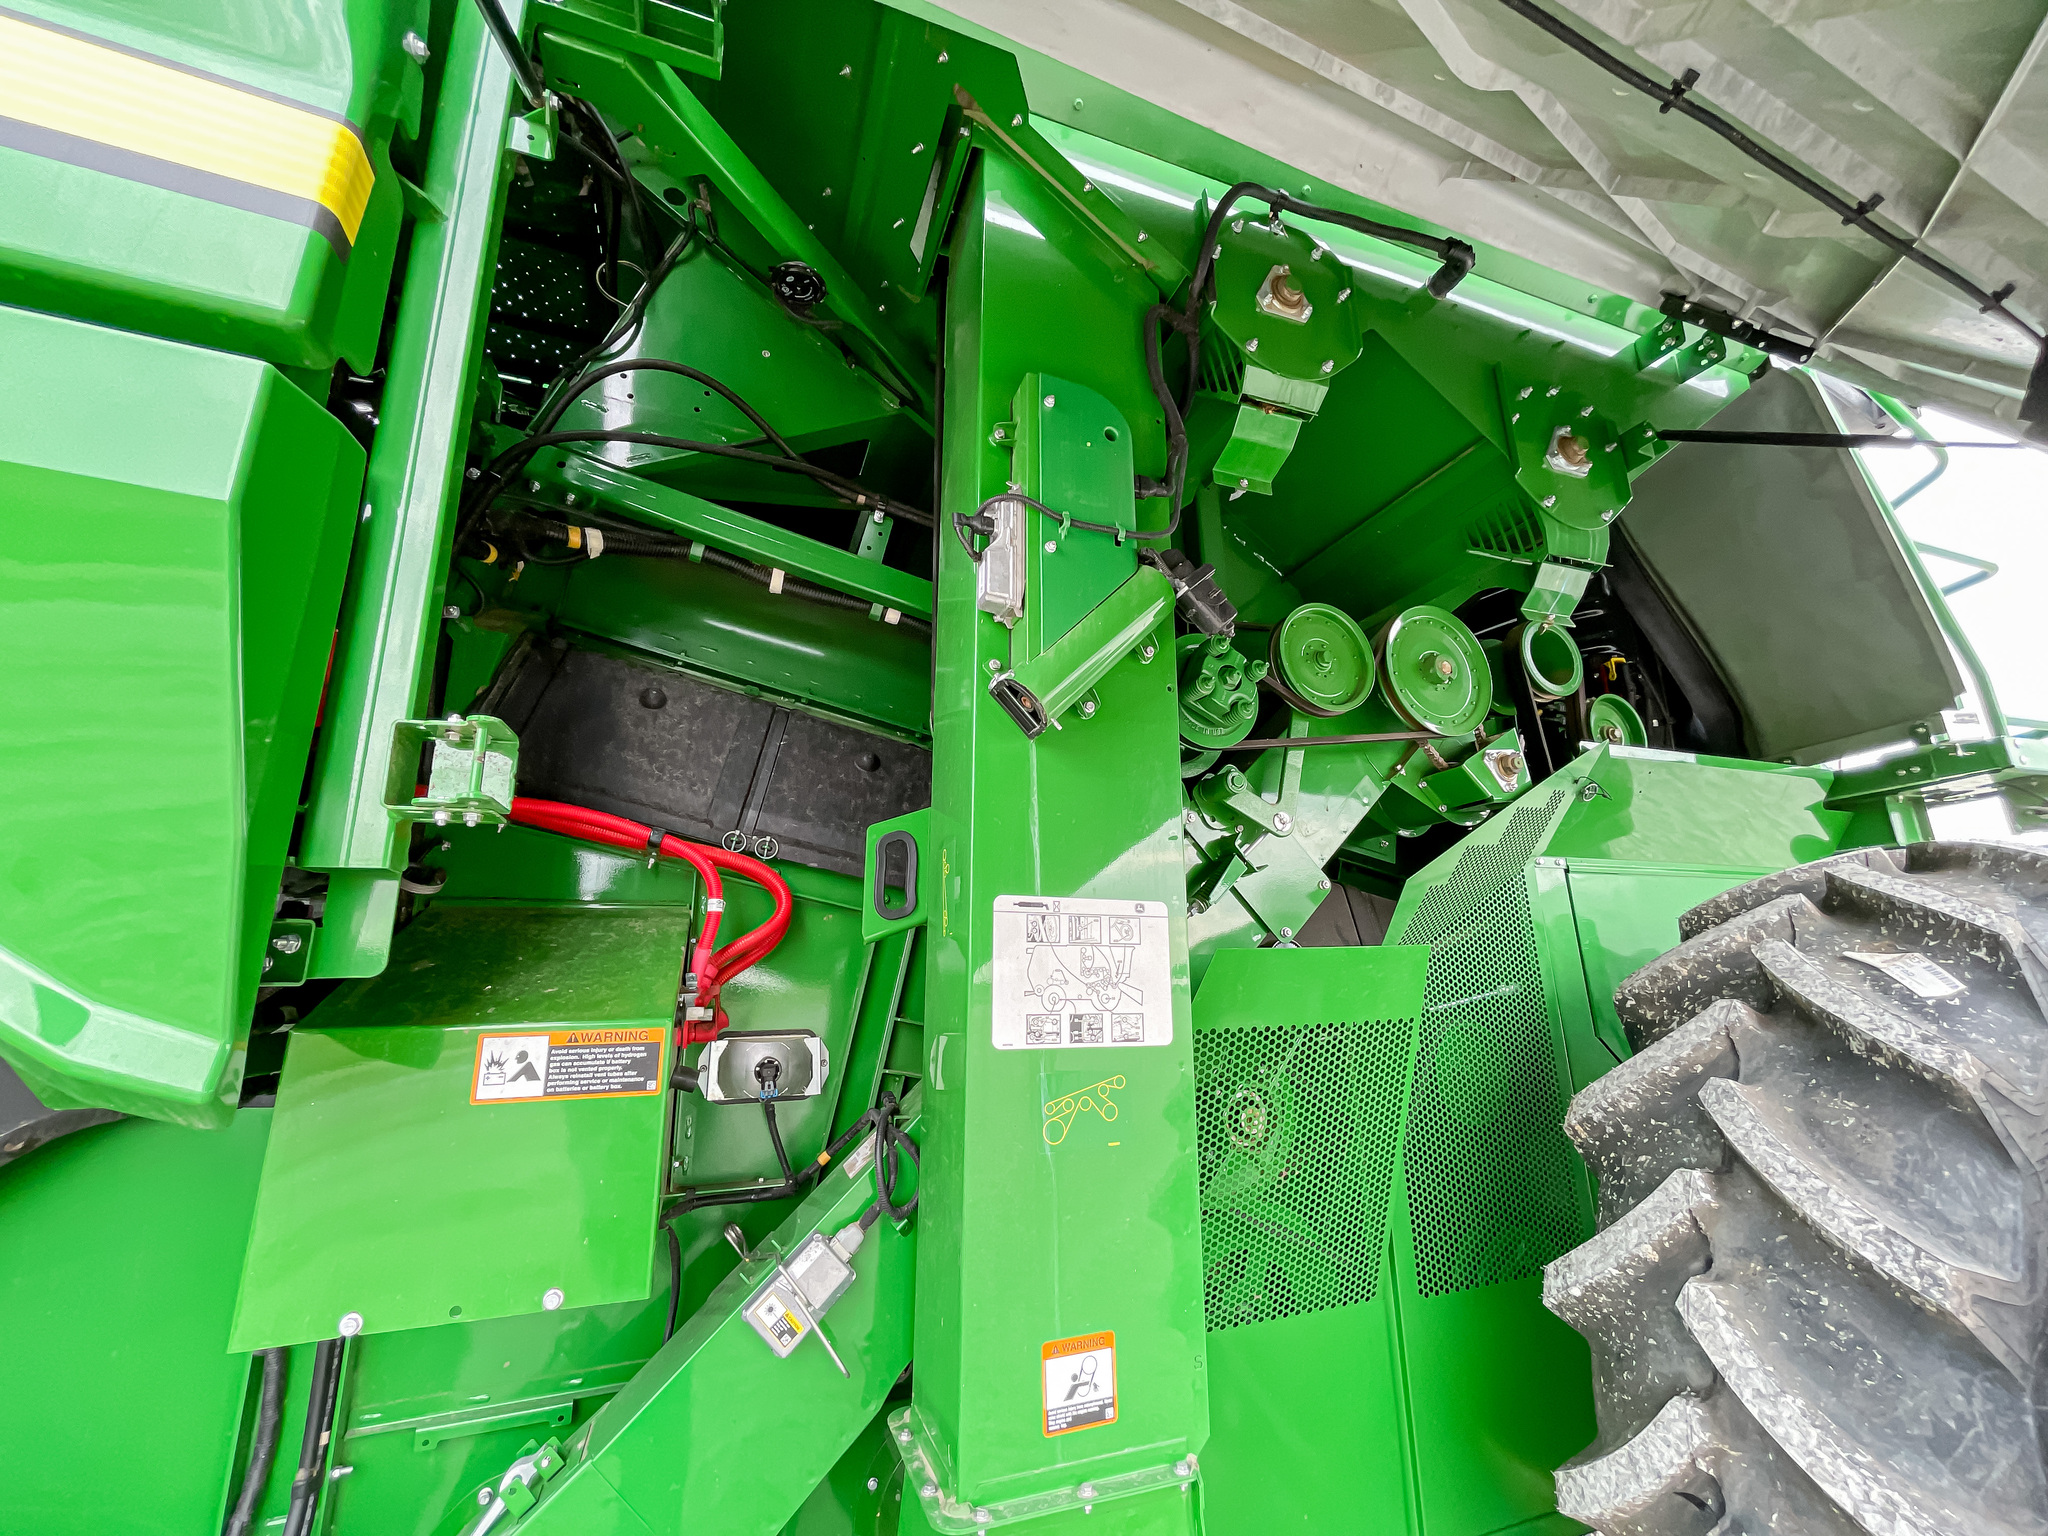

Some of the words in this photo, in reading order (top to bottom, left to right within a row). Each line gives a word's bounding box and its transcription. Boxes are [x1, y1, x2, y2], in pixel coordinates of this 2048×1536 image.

[580, 1030, 649, 1043] WARNING
[590, 1046, 608, 1054] injury
[621, 1051, 647, 1059] hydrogen
[1062, 1337, 1105, 1352] WARNING
